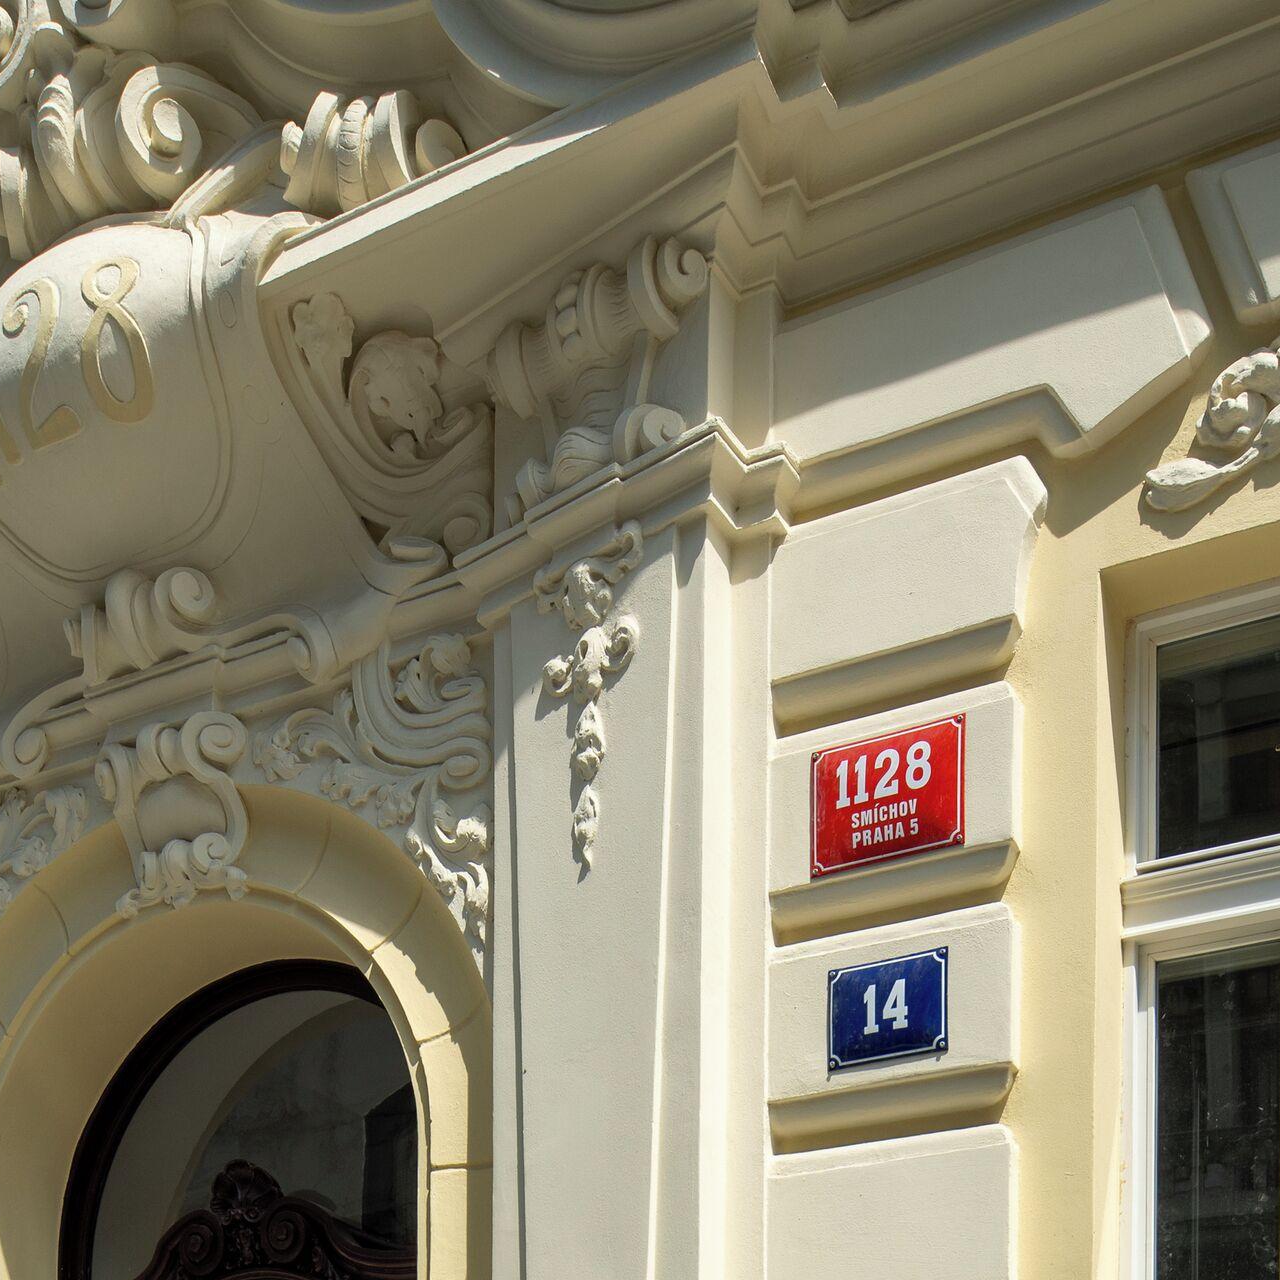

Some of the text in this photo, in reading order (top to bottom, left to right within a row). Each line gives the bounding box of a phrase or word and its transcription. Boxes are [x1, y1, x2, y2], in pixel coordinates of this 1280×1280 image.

[835, 740, 932, 810] 1128
[851, 798, 918, 829] SMÍCHOV
[851, 817, 919, 849] PRAHA 5
[863, 978, 909, 1035] 14
